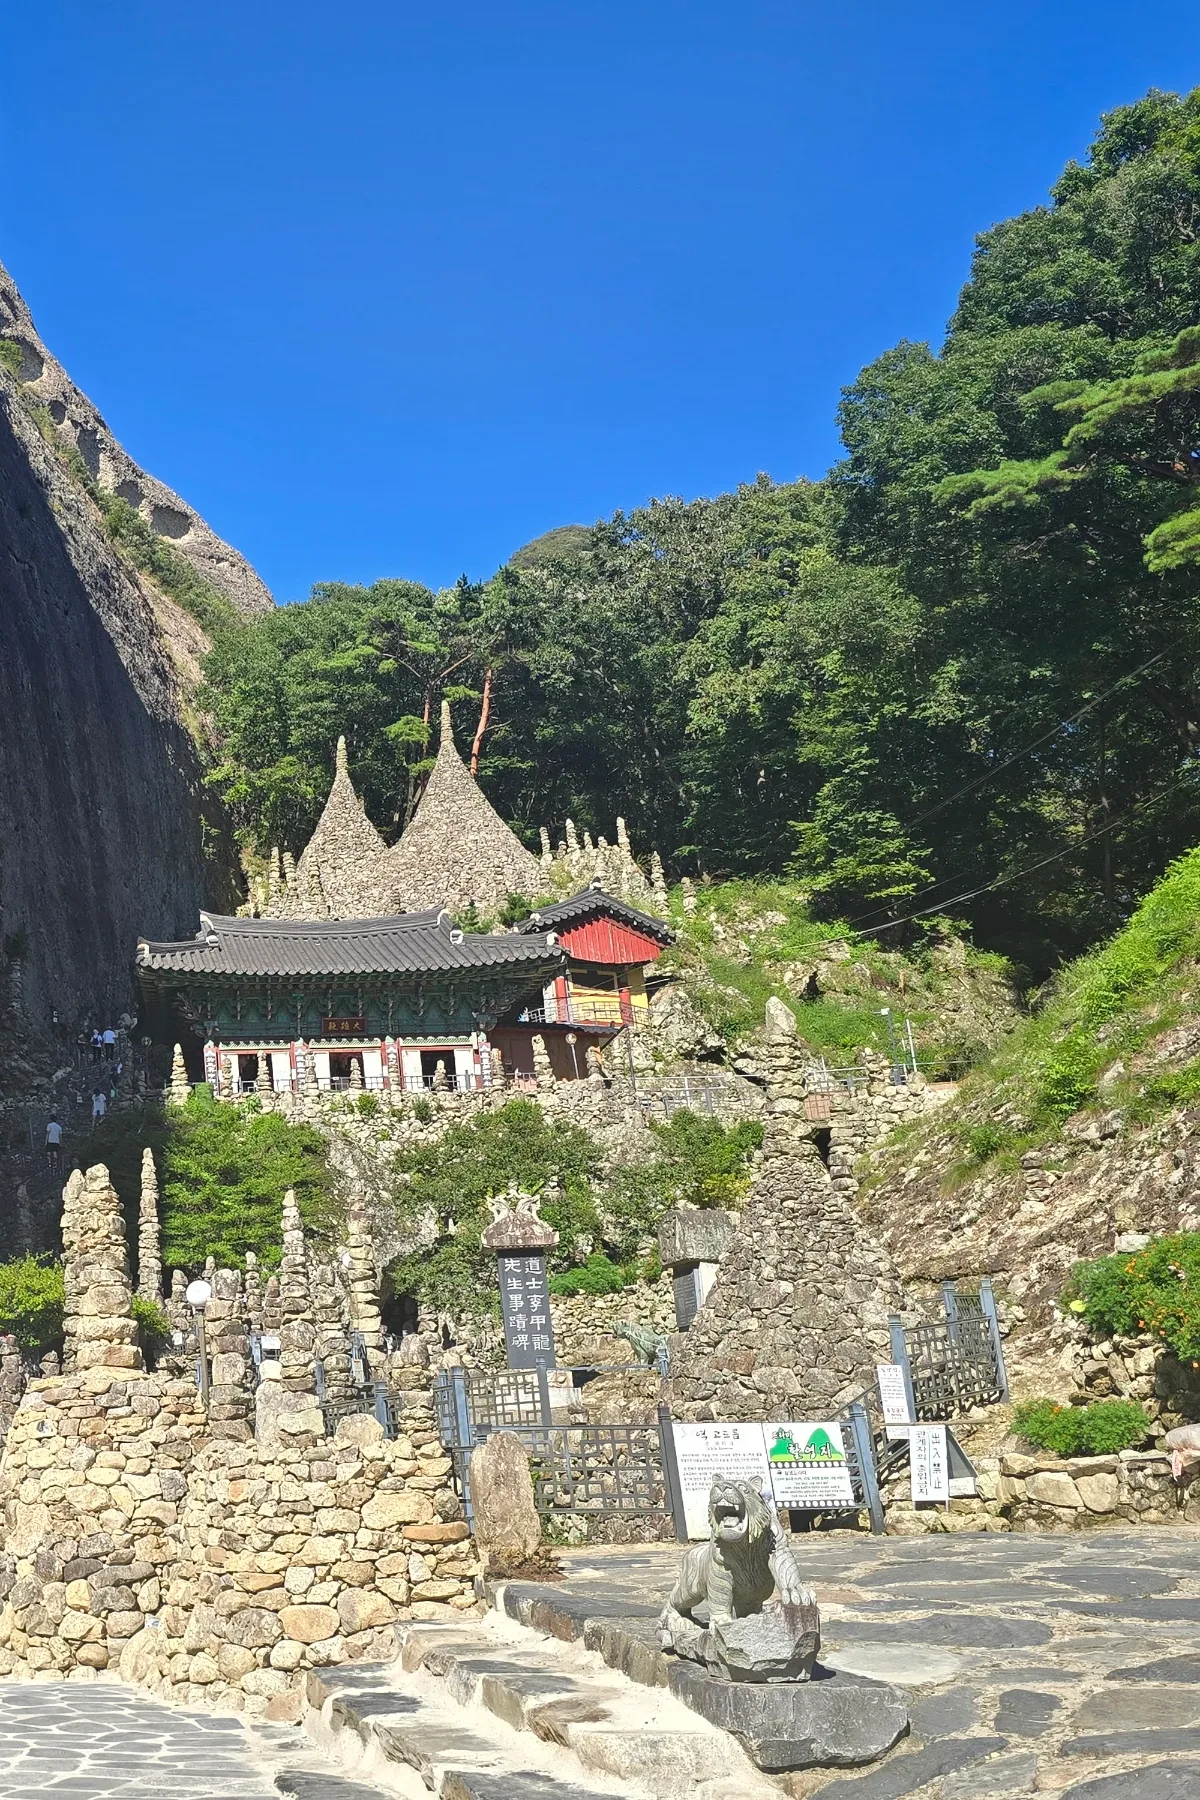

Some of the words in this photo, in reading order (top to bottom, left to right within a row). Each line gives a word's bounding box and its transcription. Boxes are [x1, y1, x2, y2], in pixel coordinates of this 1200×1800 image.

[504, 1258, 530, 1351] 先生事蹟碑
[524, 1257, 551, 1351] 道士李甲龍
[931, 1432, 943, 1489] 出入禁止
